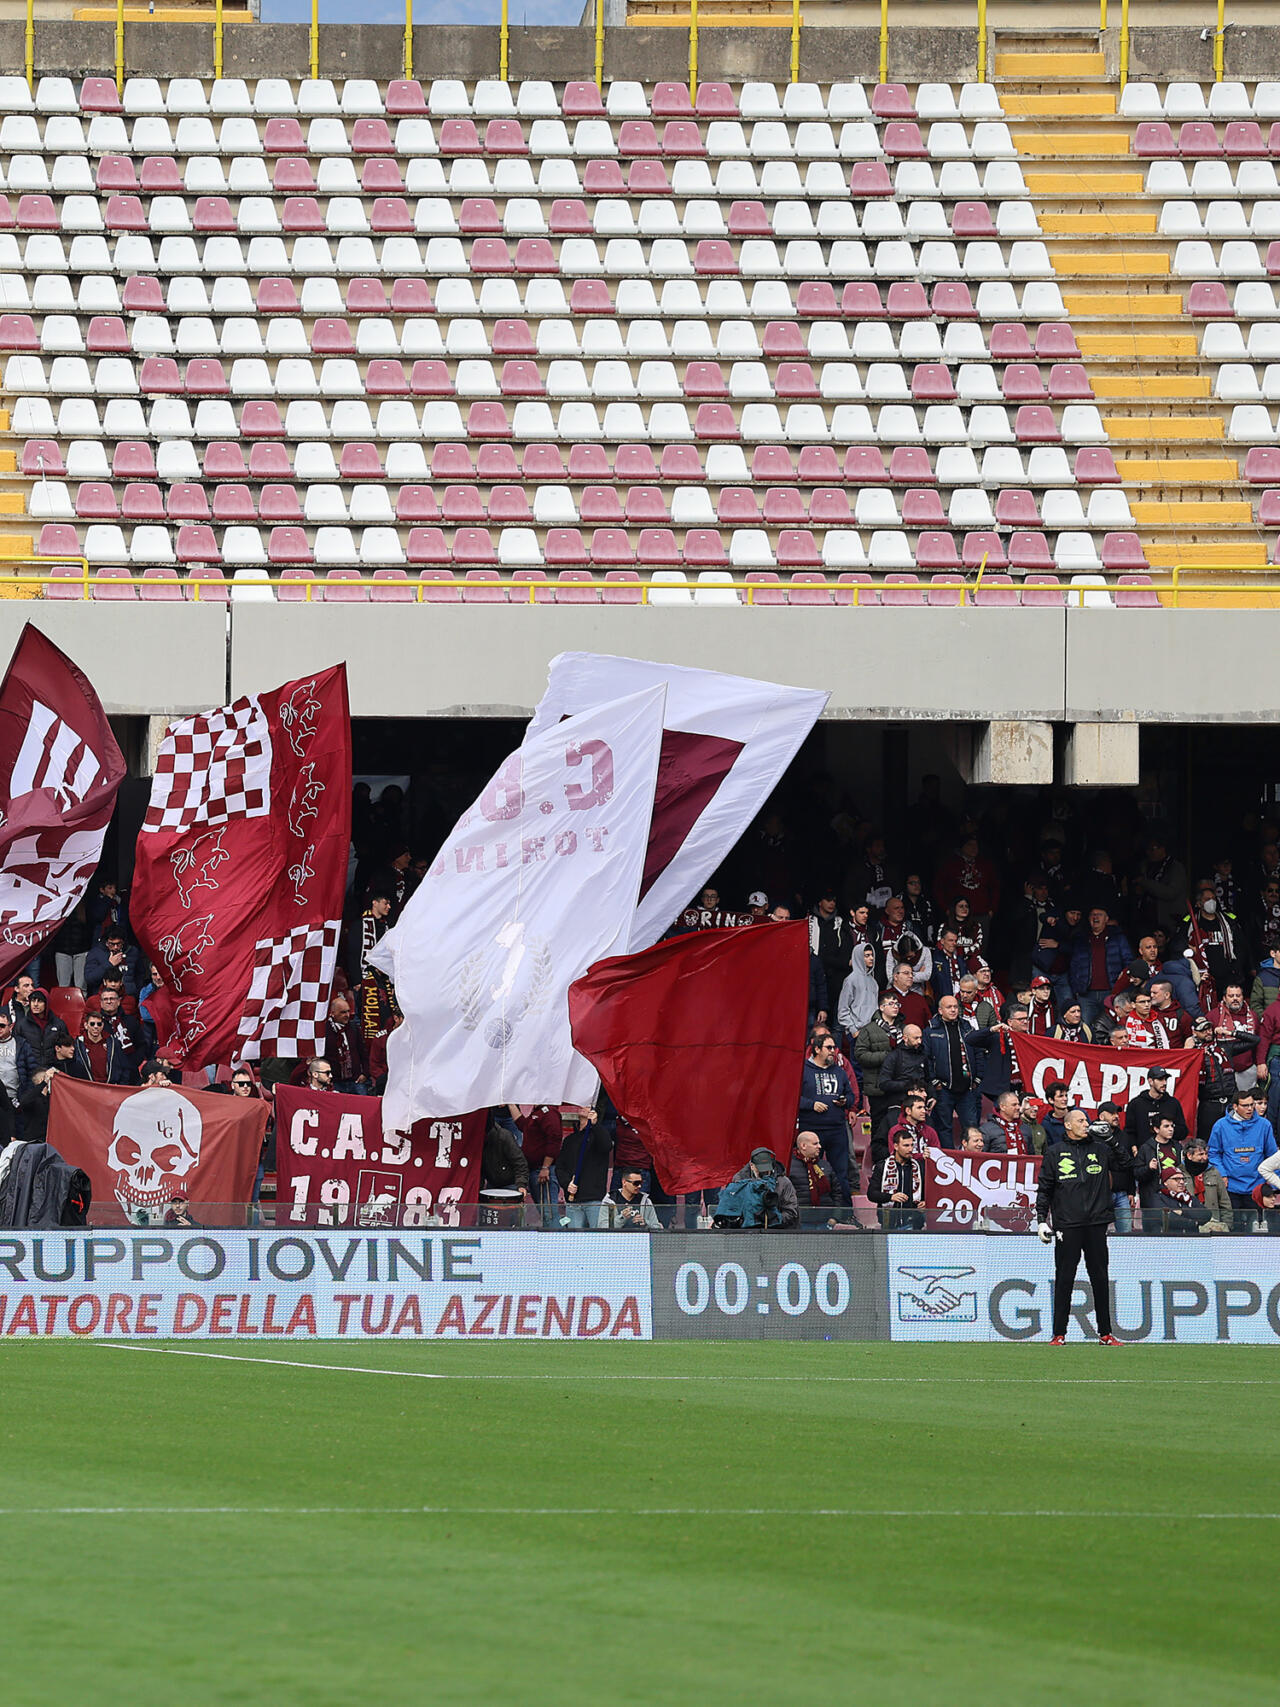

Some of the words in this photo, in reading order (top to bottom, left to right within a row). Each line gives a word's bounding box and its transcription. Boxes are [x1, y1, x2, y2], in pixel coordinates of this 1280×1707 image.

[824, 1080, 838, 1094] 57
[247, 1237, 483, 1283] IOVINE
[674, 1262, 850, 1316] 00:00
[988, 1278, 1280, 1341] GRUPP
[172, 1294, 318, 1336] DELLA
[333, 1294, 423, 1336] TUA
[435, 1295, 641, 1337] AZIENDA
